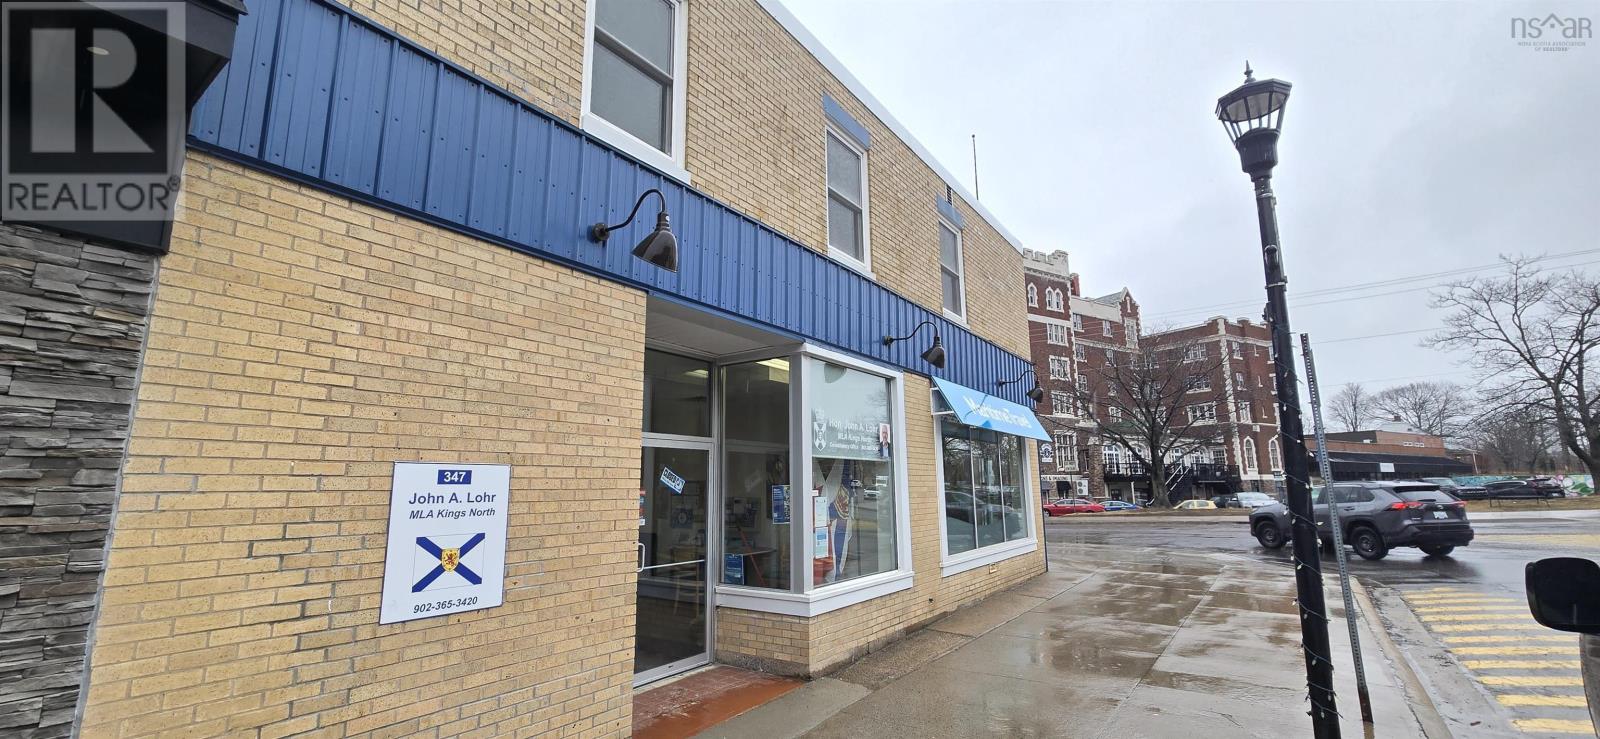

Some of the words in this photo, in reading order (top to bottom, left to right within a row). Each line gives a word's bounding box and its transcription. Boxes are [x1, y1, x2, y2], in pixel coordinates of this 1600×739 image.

[443, 471, 466, 483] 347
[408, 492, 444, 505] John
[448, 492, 463, 504] A.
[467, 491, 497, 503] Lohr
[409, 509, 434, 520] MLA
[436, 507, 467, 520] Kings
[469, 507, 496, 517] North
[413, 595, 478, 614] 902-365-3420
